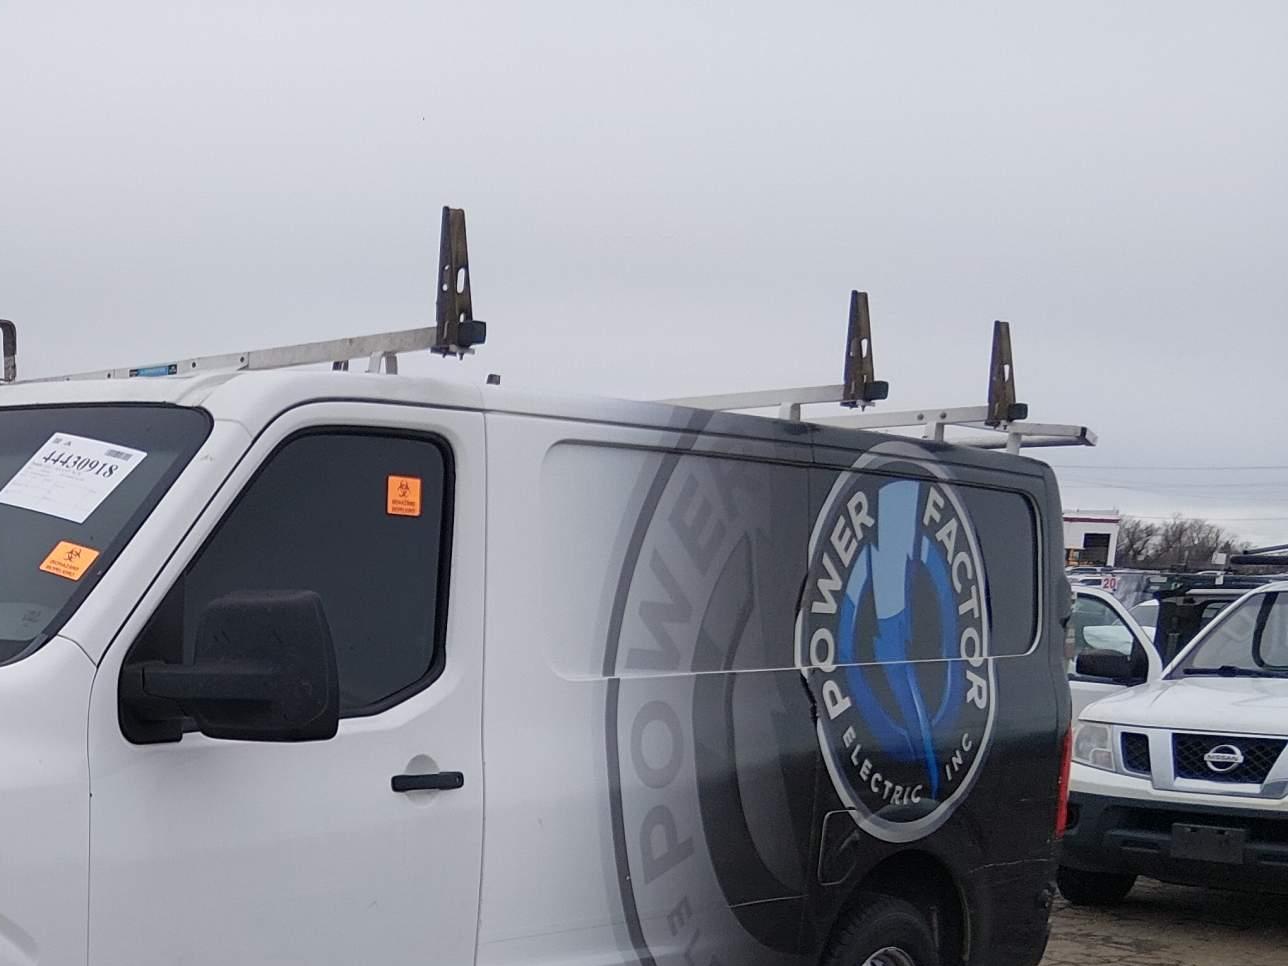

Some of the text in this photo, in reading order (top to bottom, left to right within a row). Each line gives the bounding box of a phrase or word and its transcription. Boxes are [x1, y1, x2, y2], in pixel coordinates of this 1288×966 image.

[42, 449, 119, 478] 44430918
[810, 486, 987, 720] POWER FACTOR
[1102, 577, 1117, 589] 20
[843, 726, 972, 806] ELECTRIC INC
